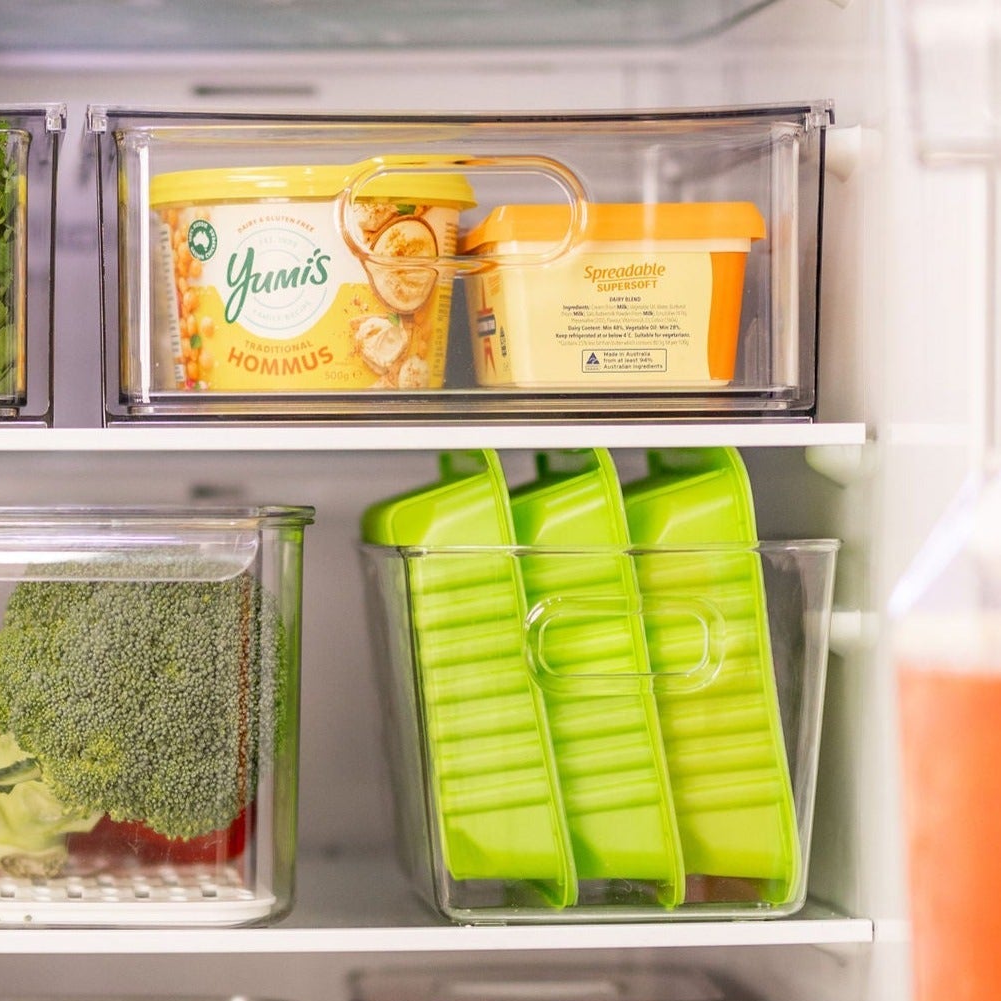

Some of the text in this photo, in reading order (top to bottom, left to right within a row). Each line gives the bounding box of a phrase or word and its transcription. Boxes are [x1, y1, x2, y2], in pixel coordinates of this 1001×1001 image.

[583, 262, 666, 283] Spreadable
[597, 280, 657, 292] SUPERSOFT
[245, 340, 314, 353] TRADITIONAL
[227, 346, 334, 376] HOMMUS
